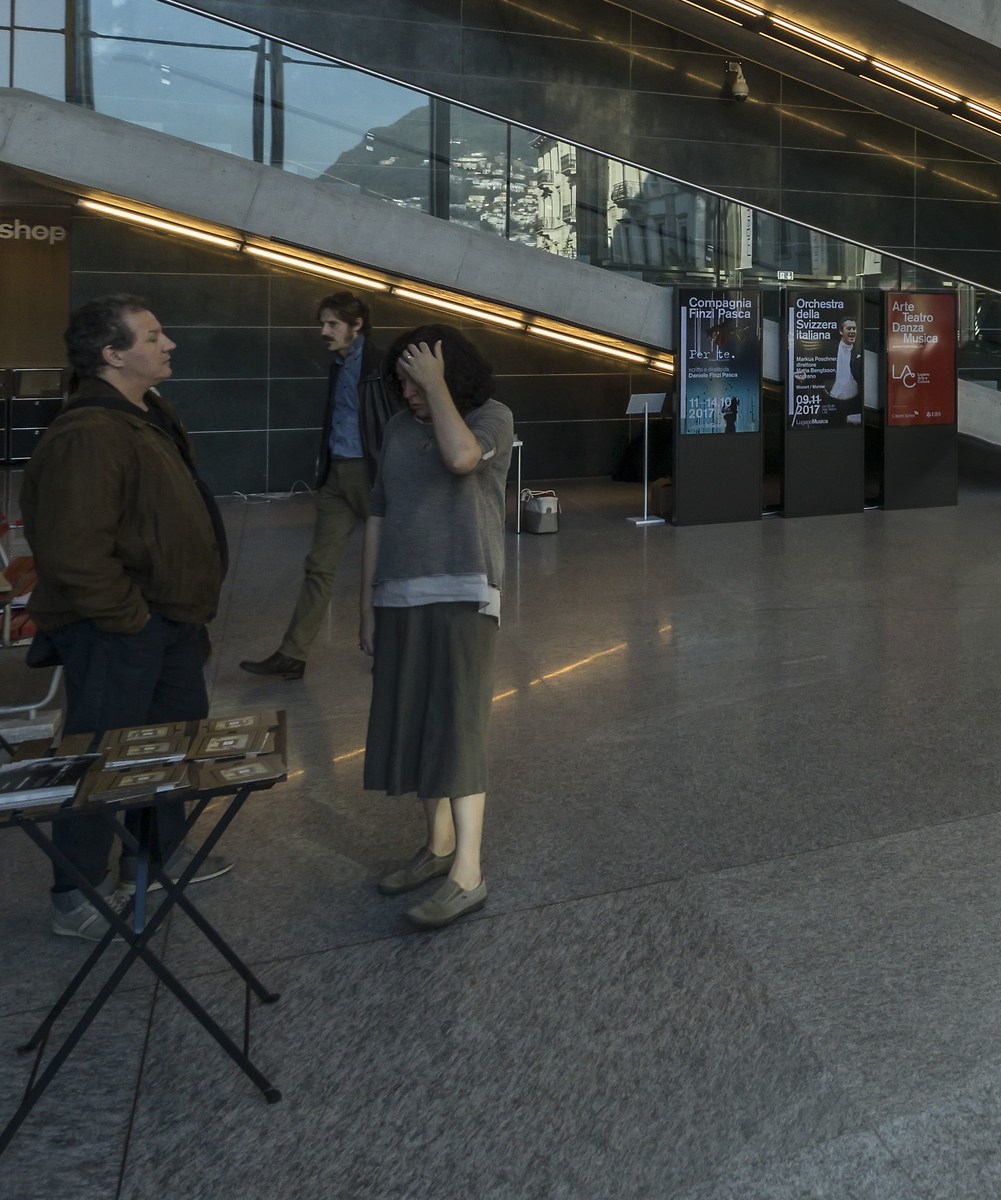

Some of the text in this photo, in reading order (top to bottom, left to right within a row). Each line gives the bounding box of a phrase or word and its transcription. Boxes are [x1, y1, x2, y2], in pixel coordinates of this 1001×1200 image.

[0, 218, 67, 245] shop
[688, 296, 752, 310] Compagnia
[796, 298, 844, 309] Orchestra
[892, 301, 915, 312] Arte
[689, 308, 751, 319] Finzi Pasca
[796, 309, 820, 319] della
[902, 312, 934, 323] Teatro
[796, 319, 838, 330] Svizzera
[892, 322, 924, 333] Danza
[796, 329, 831, 340] italiana
[903, 332, 938, 344] Musica
[689, 349, 711, 359] Per
[892, 364, 917, 389] LAC
[796, 394, 820, 405] 09.11
[688, 408, 714, 419] 2017
[796, 404, 820, 415] 2017
